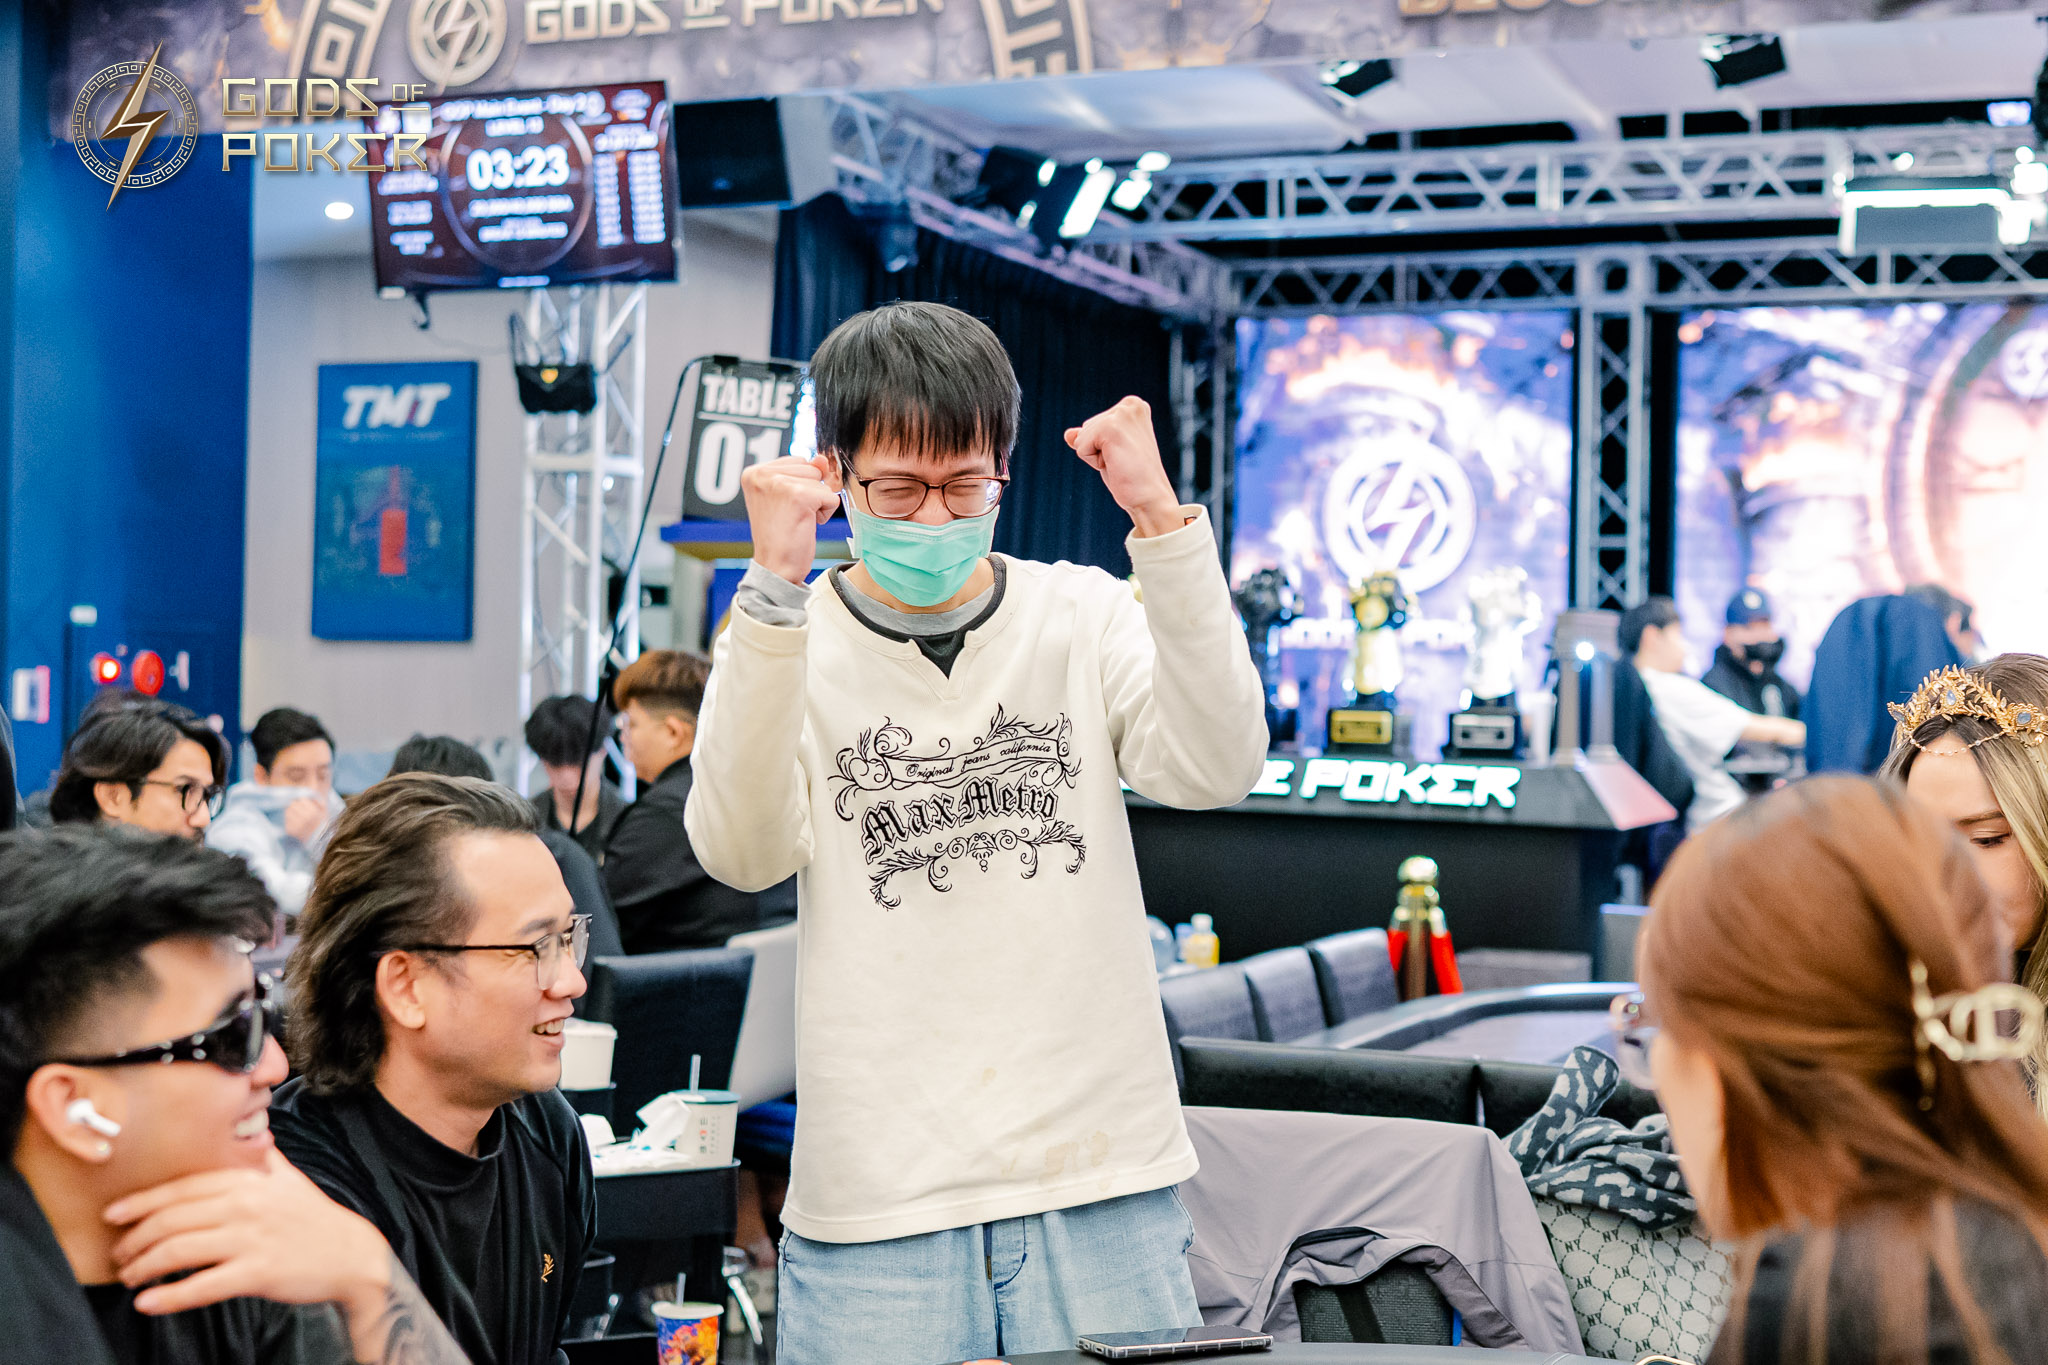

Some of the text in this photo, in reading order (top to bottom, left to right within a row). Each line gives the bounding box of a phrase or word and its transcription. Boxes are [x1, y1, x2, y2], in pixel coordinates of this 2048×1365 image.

[525, 0, 671, 44] GODS
[466, 145, 570, 191] 03:23
[342, 382, 452, 429] TMT
[702, 373, 796, 421] TABLE
[905, 740, 1051, 783] Original jeans california
[1298, 758, 1521, 808] POKER
